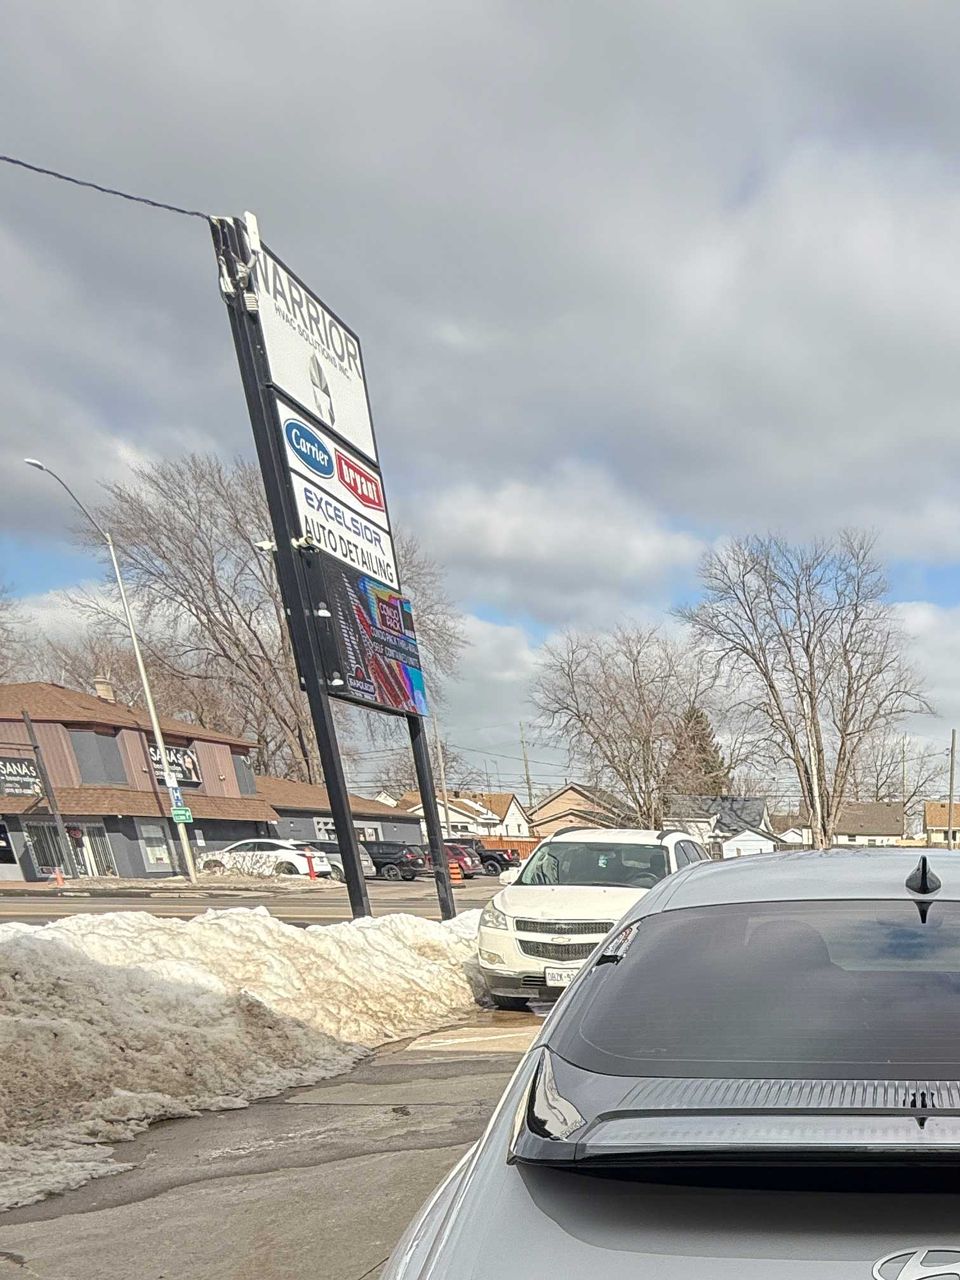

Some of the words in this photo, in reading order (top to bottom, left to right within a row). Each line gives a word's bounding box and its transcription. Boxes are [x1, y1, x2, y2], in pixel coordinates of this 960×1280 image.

[253, 250, 362, 379] WARRIOR
[275, 302, 296, 330] HVAC
[297, 323, 338, 368] SOLUTIONS
[291, 428, 329, 468] Carrier
[342, 459, 379, 504] bryant
[304, 486, 386, 556] EXCELSIOR
[304, 515, 338, 553] AUTO
[338, 534, 394, 583] DETAILING
